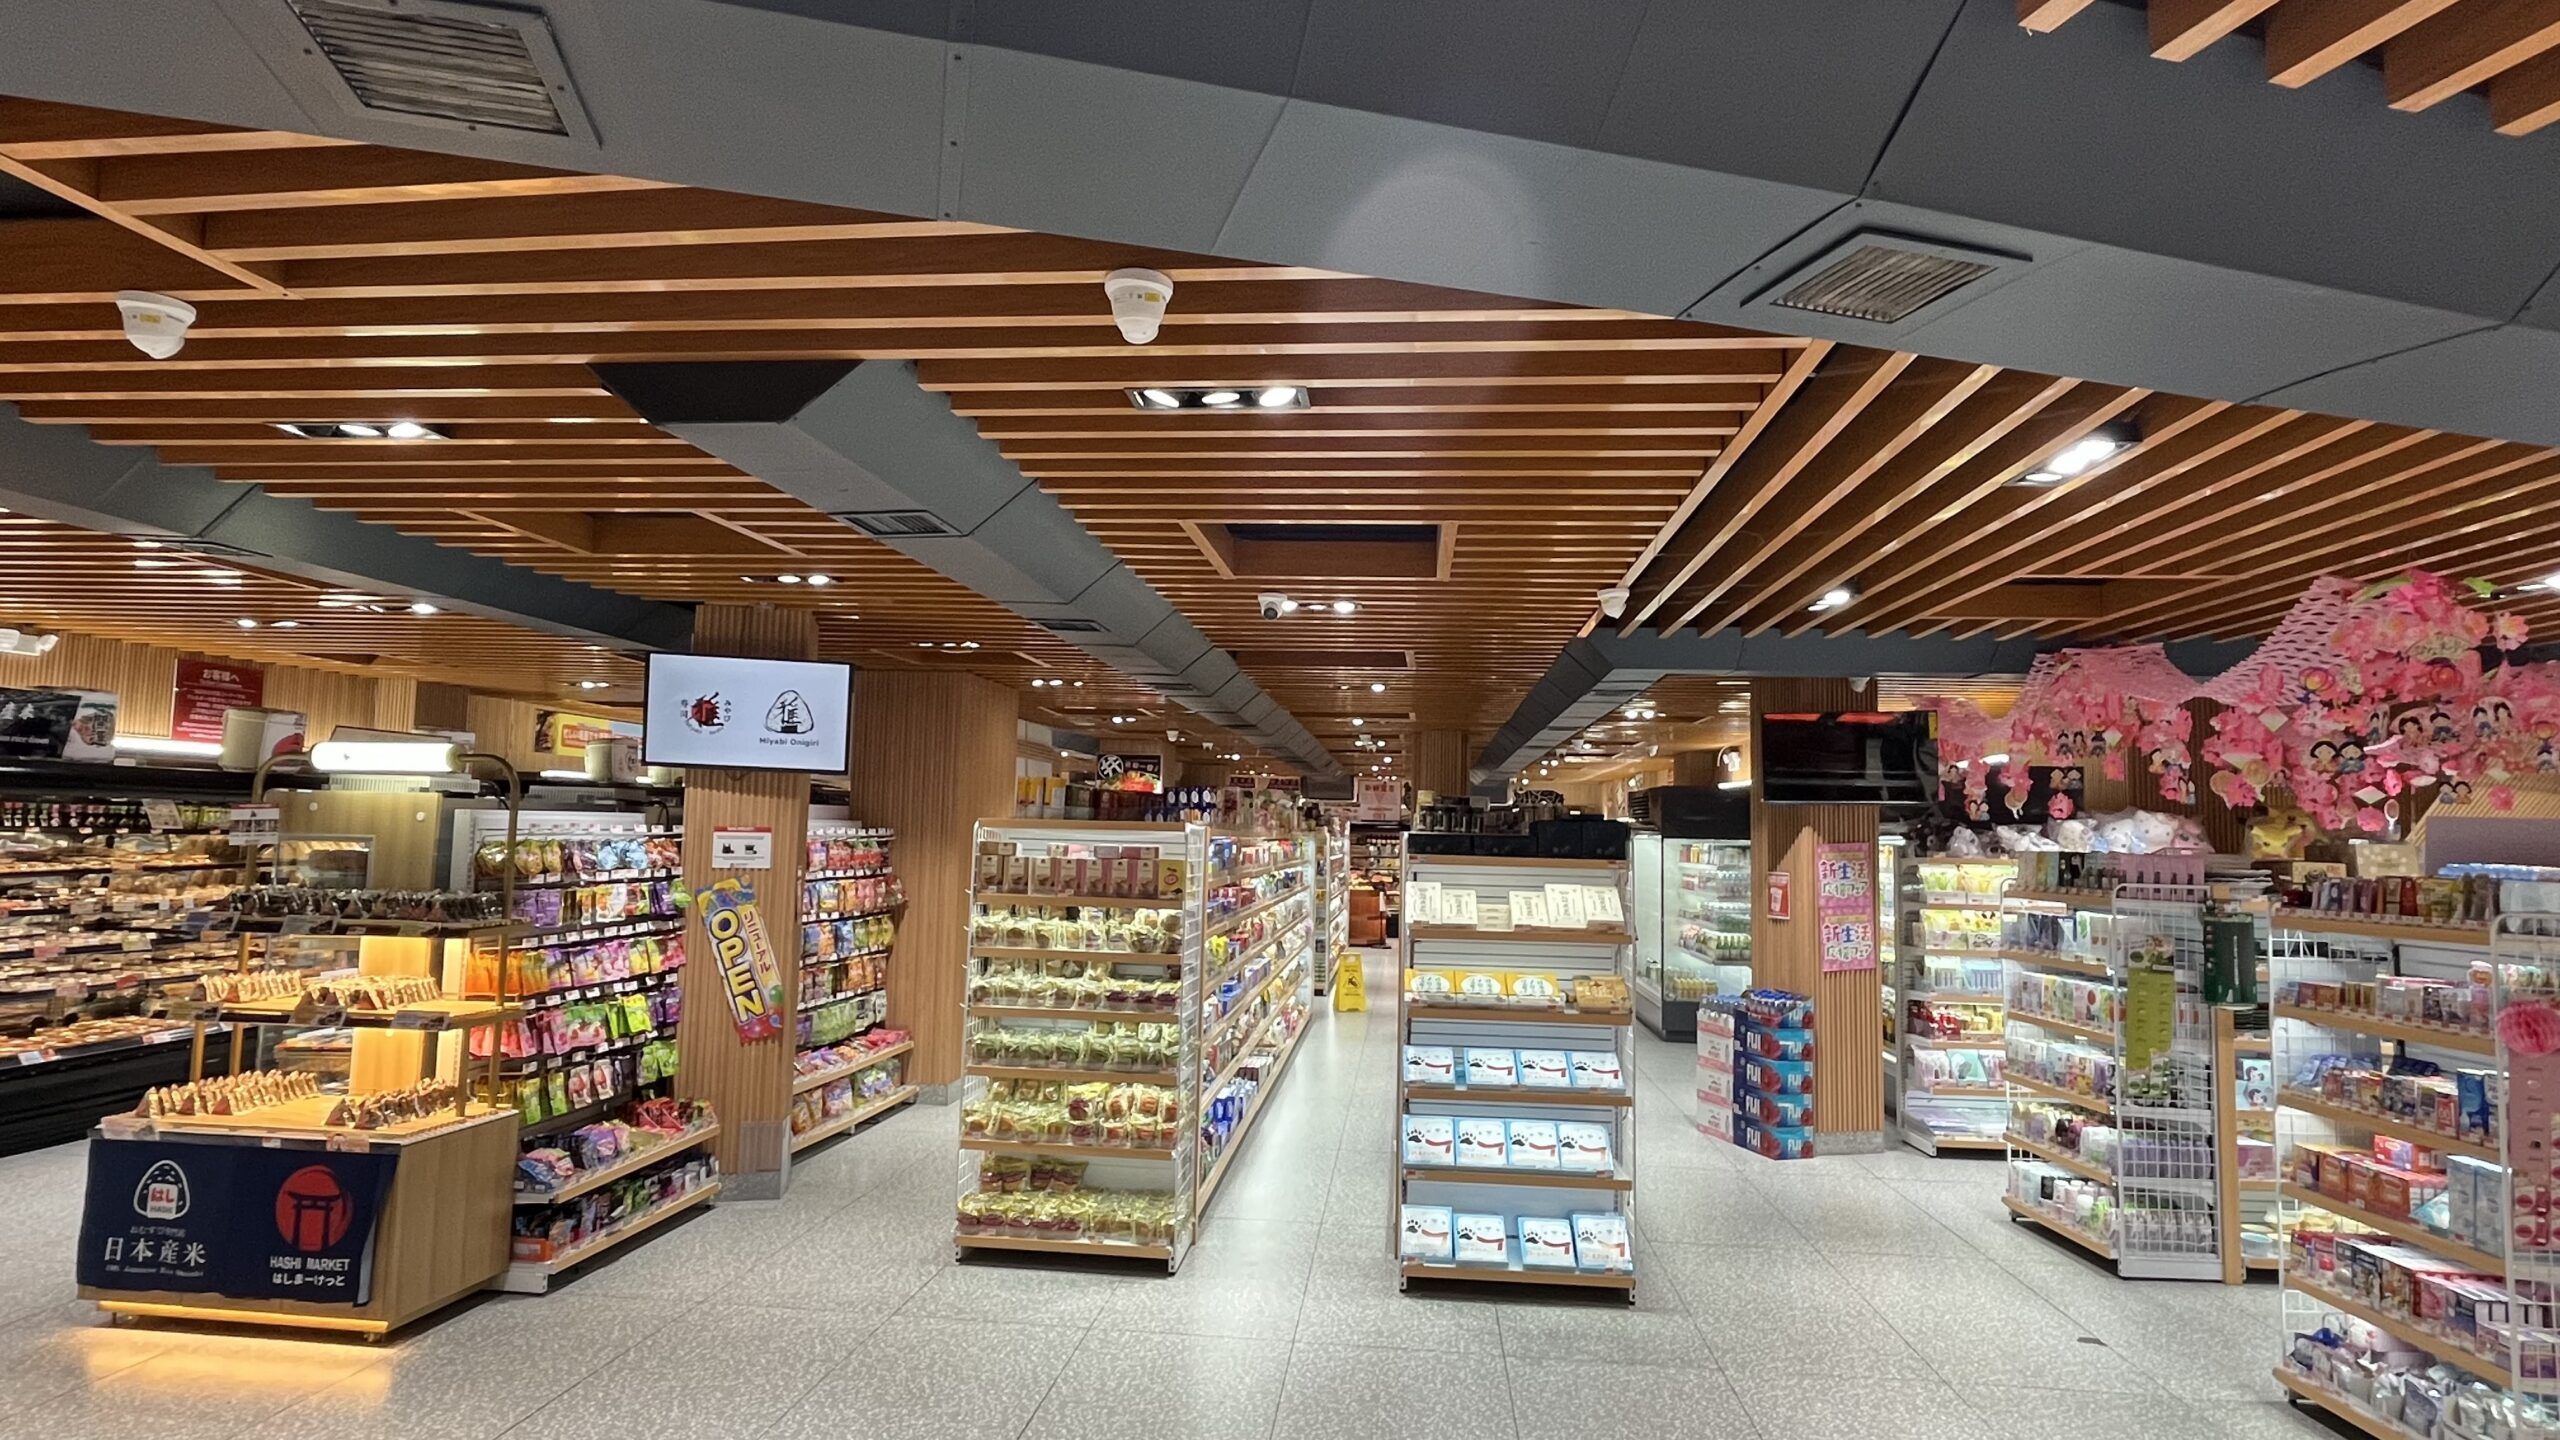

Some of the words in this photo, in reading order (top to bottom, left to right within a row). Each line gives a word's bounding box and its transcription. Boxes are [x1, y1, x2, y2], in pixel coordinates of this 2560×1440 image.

[759, 738, 787, 746] Miyabi
[789, 738, 820, 748] Onigiri
[1820, 861, 1867, 879] 新生活
[744, 910, 771, 975] リニューアル
[1824, 925, 1871, 943] 新生活
[709, 908, 766, 1024] OPEN
[1747, 1032, 1761, 1051] FIJI
[1747, 1064, 1761, 1085] FIJI
[1746, 1095, 1760, 1116] FIJI
[1747, 1128, 1760, 1148] FIJI
[151, 1187, 175, 1204] はし
[104, 1237, 206, 1267] 日本産米
[270, 1256, 302, 1270] HASHI
[306, 1257, 351, 1272] MARKET
[272, 1272, 346, 1288] はしまーけっと
